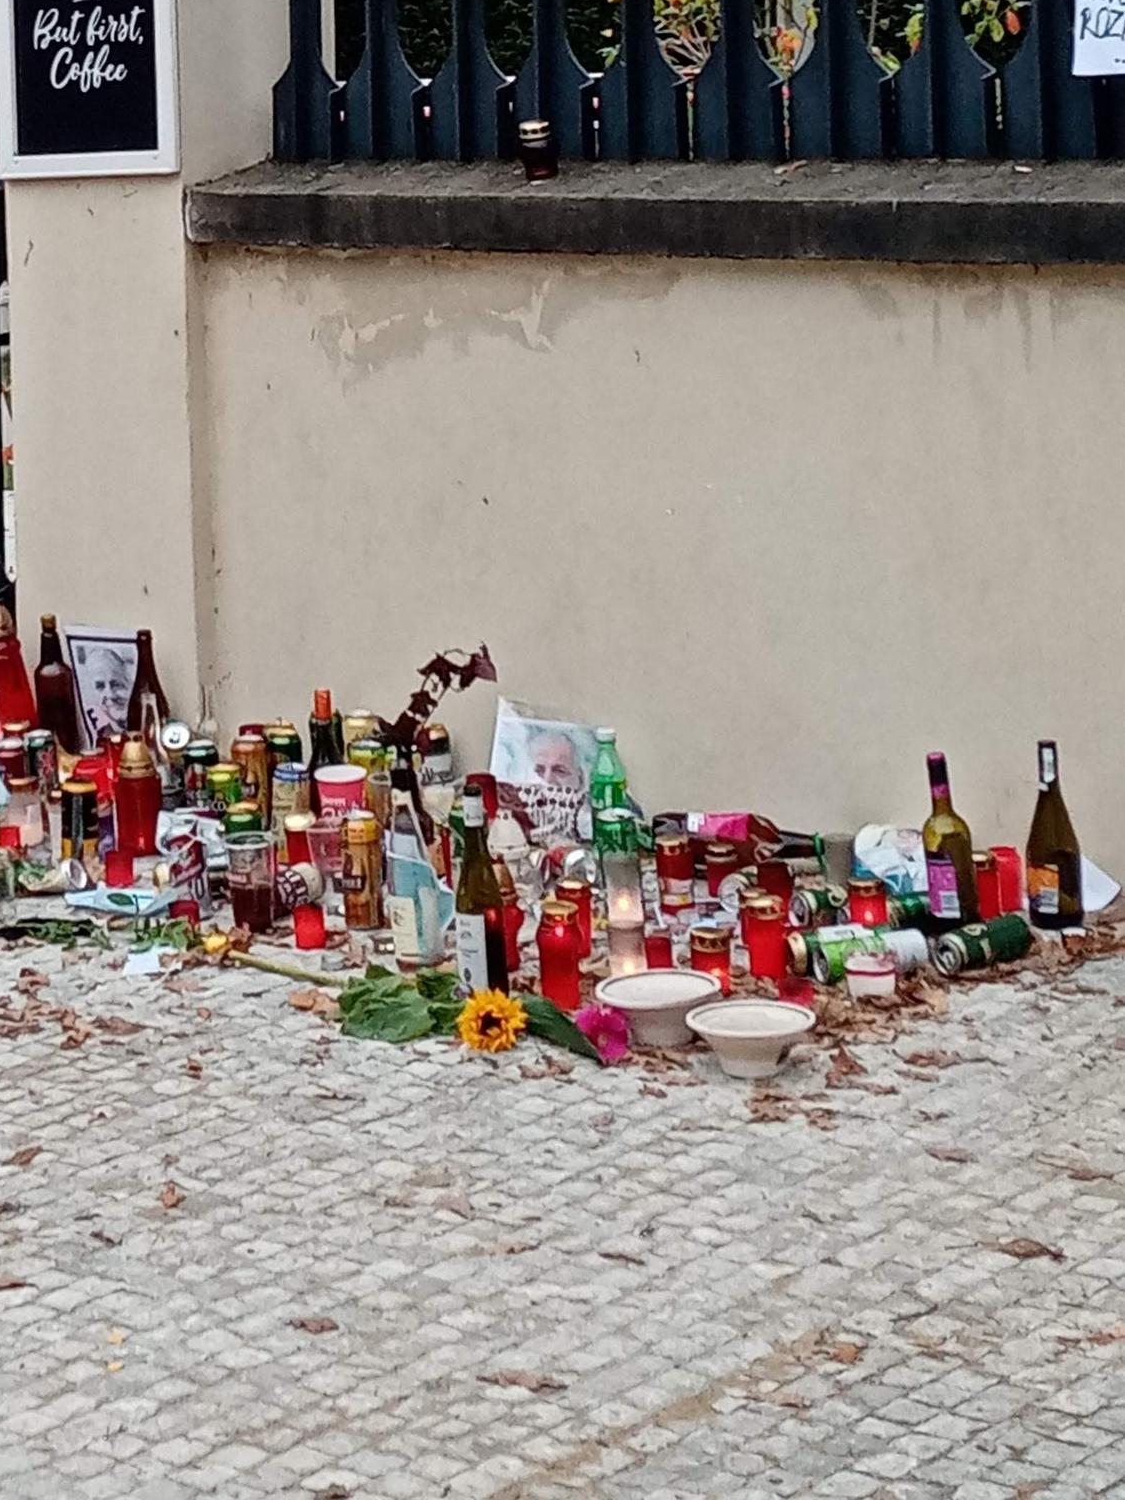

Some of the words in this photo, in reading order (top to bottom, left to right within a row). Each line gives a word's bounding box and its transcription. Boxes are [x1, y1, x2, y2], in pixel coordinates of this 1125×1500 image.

[33, 8, 85, 50] But
[86, 6, 146, 46] first,
[1080, 6, 1125, 41] ROZ
[50, 44, 128, 93] Coffee
